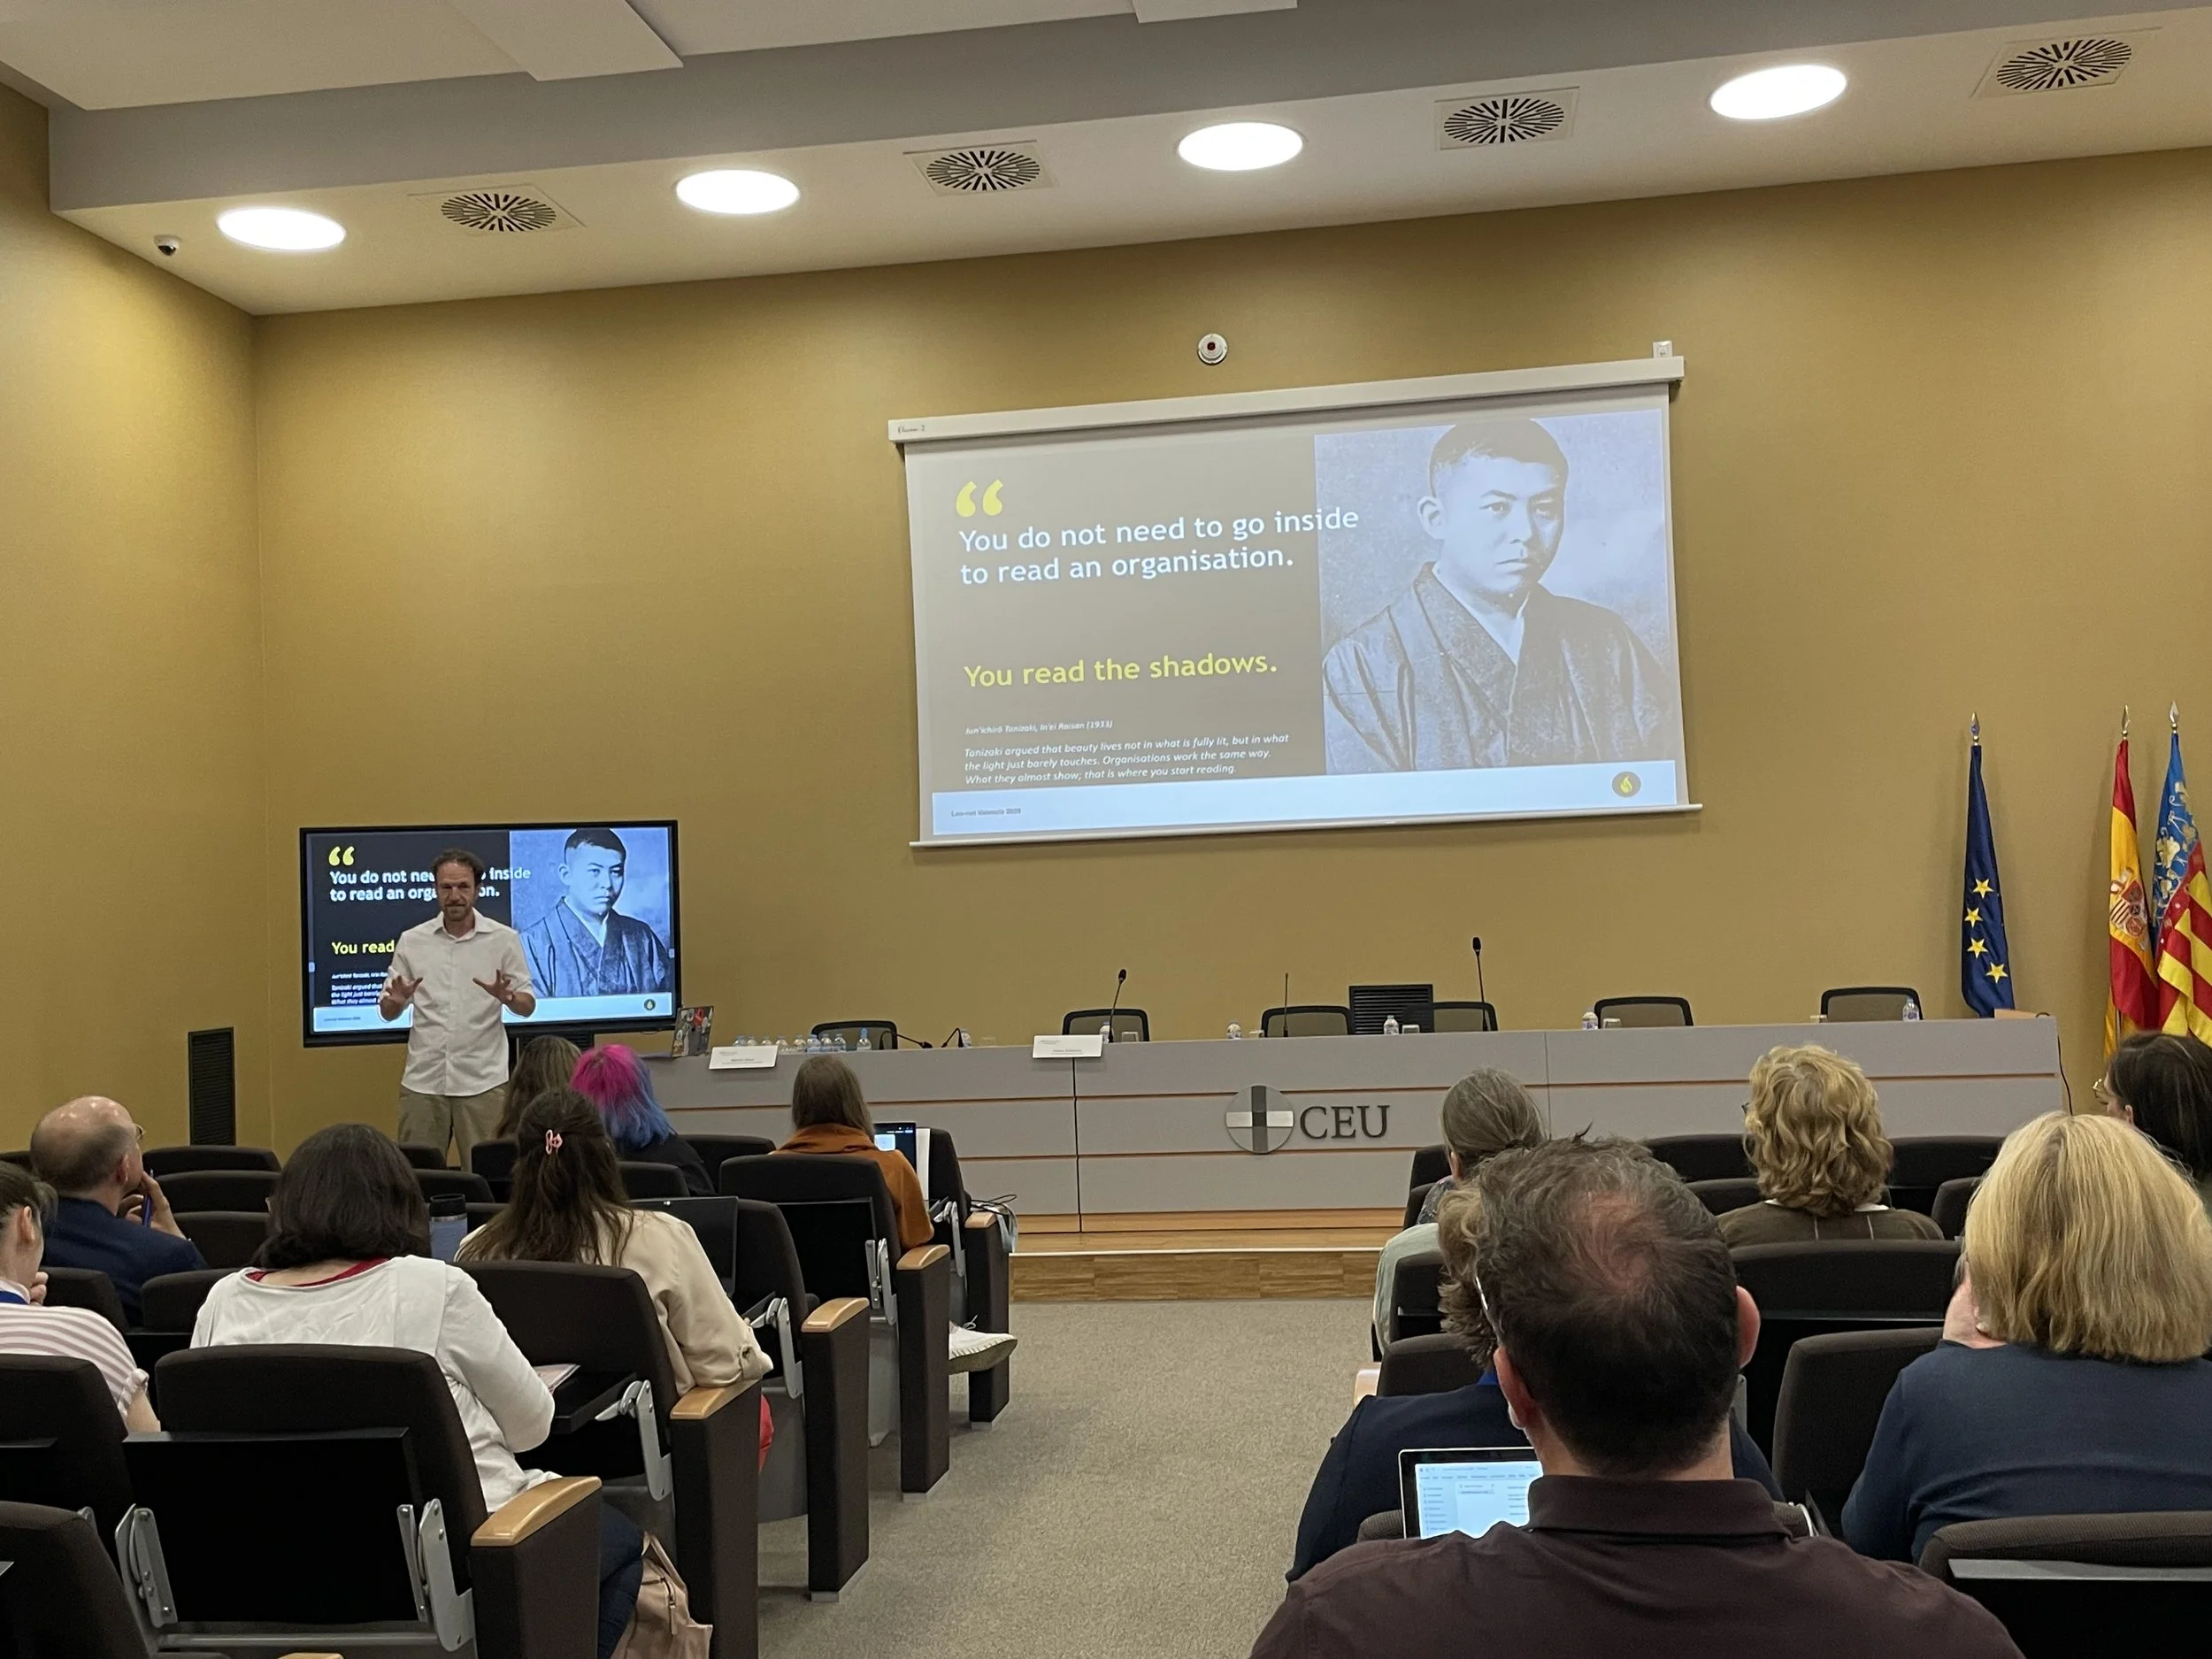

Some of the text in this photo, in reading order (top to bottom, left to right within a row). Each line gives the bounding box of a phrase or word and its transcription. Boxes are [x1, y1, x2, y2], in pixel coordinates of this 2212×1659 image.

[959, 507, 1359, 552] You do not need to go inside
[961, 546, 1294, 584] to read an organisation.
[964, 652, 1278, 687] You read the shadows.
[964, 733, 1289, 757] Tanizaki argued that beauty lives not in what is fully lit, but in what
[964, 761, 980, 771] the
[982, 760, 1004, 772] light
[1005, 759, 1025, 771] just
[1026, 757, 1057, 770] barely
[1060, 756, 1100, 766] touches.
[1102, 753, 1171, 766] Organisations
[1173, 751, 1198, 762] work
[1201, 750, 1217, 760] the
[1248, 749, 1271, 760] way.
[965, 764, 1236, 785] What they almost show; that is where you start reading.
[329, 871, 357, 885] You
[360, 870, 379, 883] do
[382, 869, 407, 882] not
[488, 866, 531, 880] inside
[329, 888, 347, 902] to
[349, 887, 383, 901] read
[386, 888, 404, 900] an
[331, 940, 396, 956] You read
[1300, 1105, 1391, 1140] CEU
